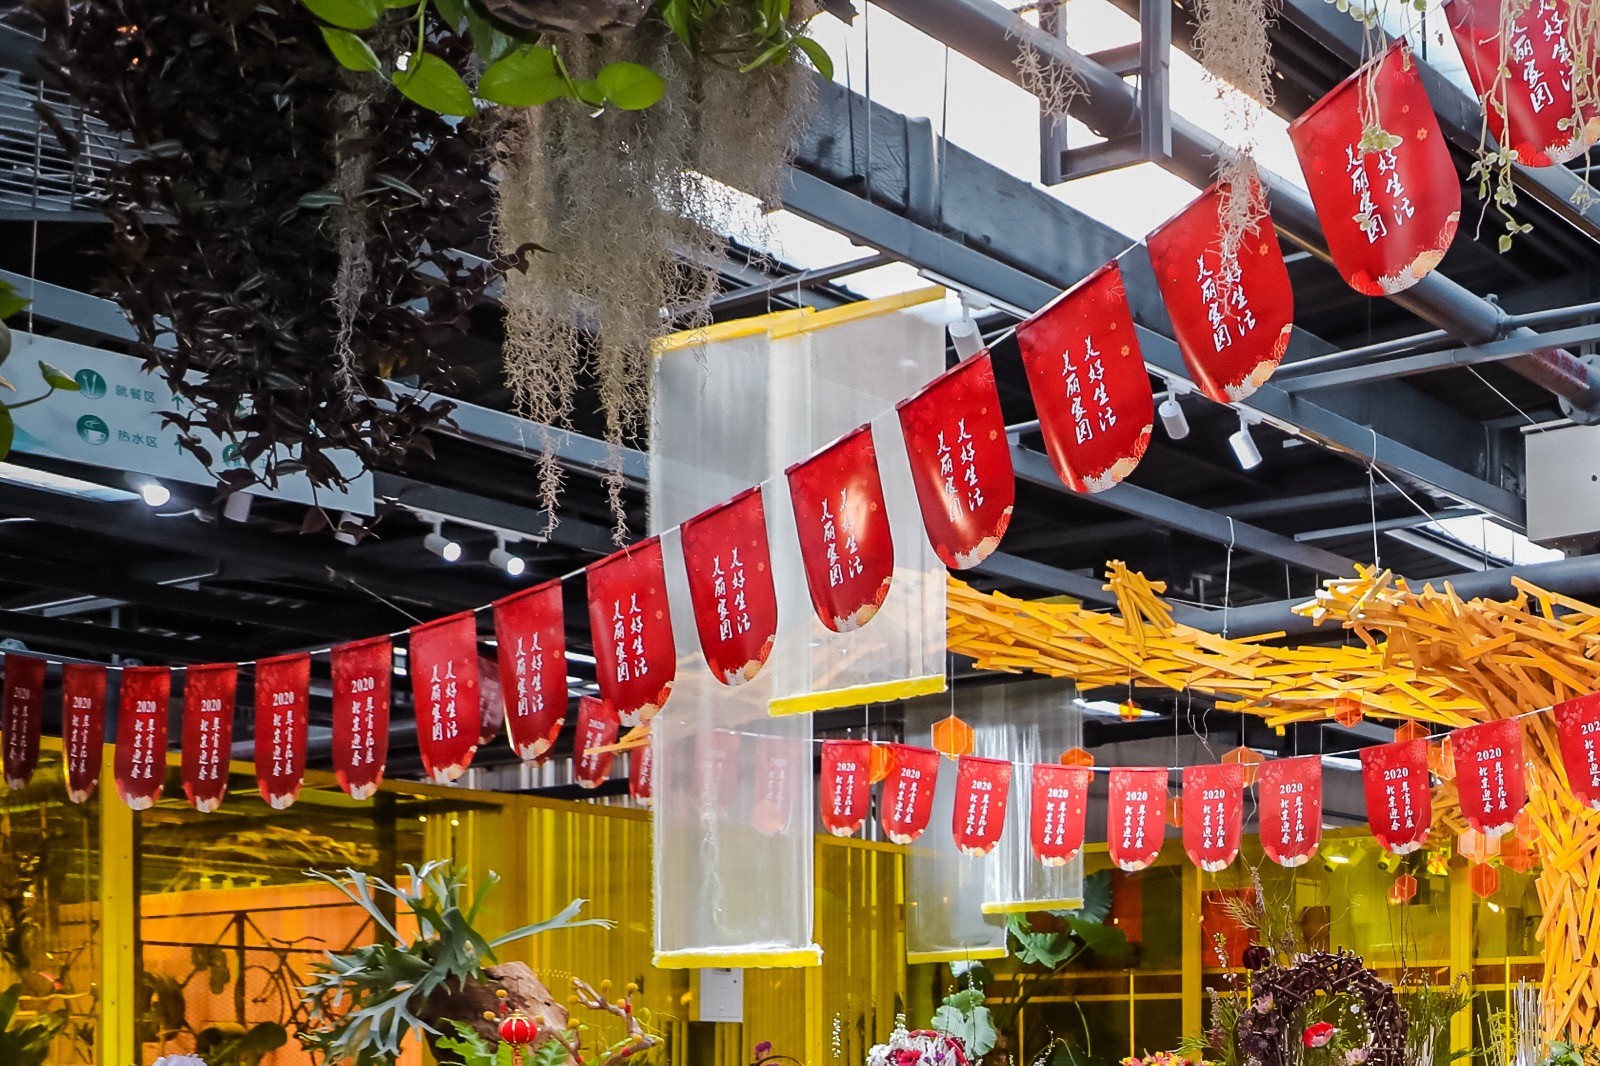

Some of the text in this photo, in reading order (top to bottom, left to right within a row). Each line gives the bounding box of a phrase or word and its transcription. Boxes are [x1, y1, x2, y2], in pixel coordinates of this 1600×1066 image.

[1345, 143, 1388, 244] 美丽家园
[1377, 148, 1416, 226] 好生活
[1196, 254, 1232, 353] 美丽家园
[115, 384, 157, 404] 就餐区
[1061, 350, 1094, 445] 美丽家园
[1084, 334, 1117, 432] 美好生活
[117, 430, 158, 449] 热水区
[937, 430, 964, 523] 美丽家园
[958, 417, 985, 512] 美好生活
[821, 498, 844, 588] 美丽家园
[712, 555, 733, 642] 美丽家园
[730, 547, 751, 634] 美好生活
[612, 599, 630, 683] 美丽家园
[629, 593, 648, 678] 美好生活
[351, 676, 375, 694] 2020
[516, 637, 529, 717] 美丽家园
[531, 631, 544, 713] 美好生活
[72, 697, 92, 709] 2020
[136, 700, 157, 713] 2020
[201, 699, 222, 712] 2020
[272, 691, 295, 707] 2020
[430, 663, 444, 742] 美丽家园
[445, 659, 459, 739] 美好生活
[836, 762, 856, 772] 2020
[901, 767, 921, 780] 2020
[1383, 767, 1409, 780] 2020
[1476, 747, 1502, 762] 2020
[971, 780, 992, 791] 2020
[1047, 788, 1069, 799] 2020
[1125, 791, 1148, 801] 2020
[1202, 788, 1225, 800] 2020
[1279, 783, 1303, 795] 2020
[1386, 785, 1401, 831] 北京迎春
[1400, 781, 1415, 828] 年宵花展
[1478, 766, 1494, 813] 北京迎春
[1494, 761, 1508, 810] 年宵花展
[1202, 805, 1213, 849] 北京迎春
[1215, 802, 1226, 848] 年宵花展
[1279, 798, 1291, 845] 北京迎春
[1293, 795, 1305, 843] 年宵花展
